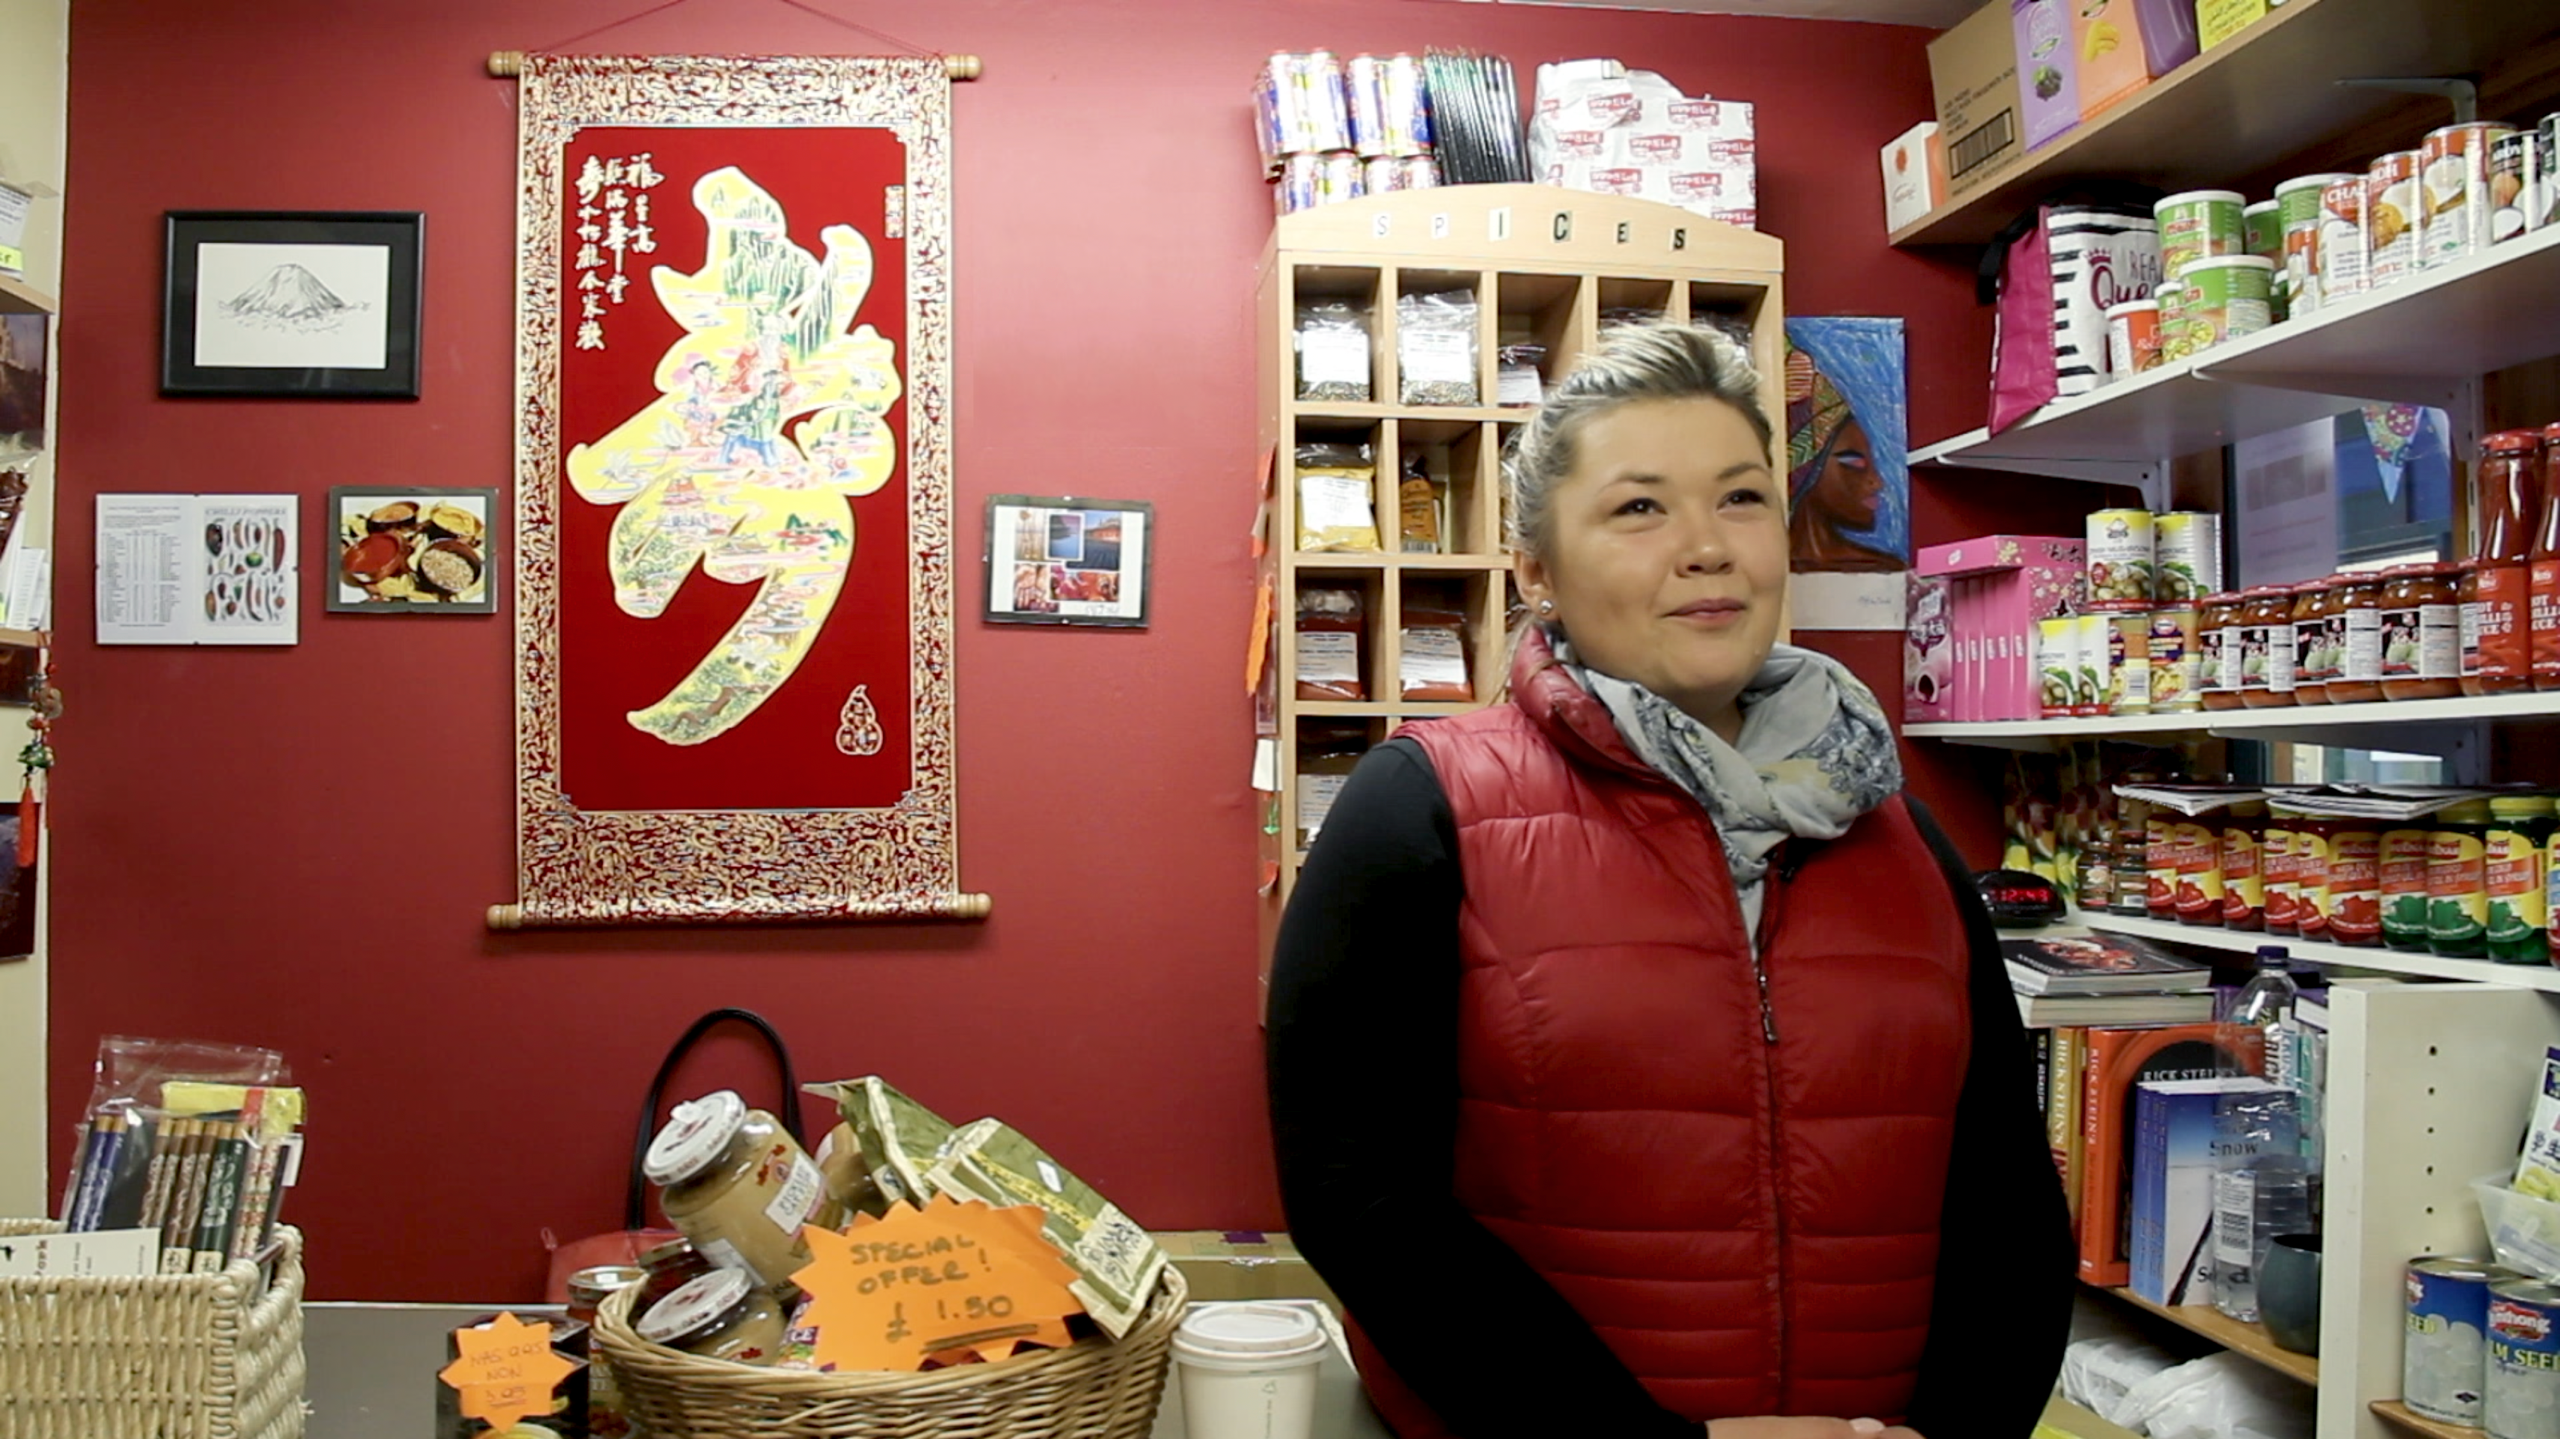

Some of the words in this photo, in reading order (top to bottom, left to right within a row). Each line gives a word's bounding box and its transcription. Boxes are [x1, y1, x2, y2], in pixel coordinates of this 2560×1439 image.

[2327, 184, 2361, 203] CHA
[1377, 212, 1686, 250] SPICES
[2129, 250, 2160, 282] REA
[2090, 265, 2149, 312] Que
[850, 1234, 976, 1267] SPECIAL
[2407, 1313, 2437, 1335] EED
